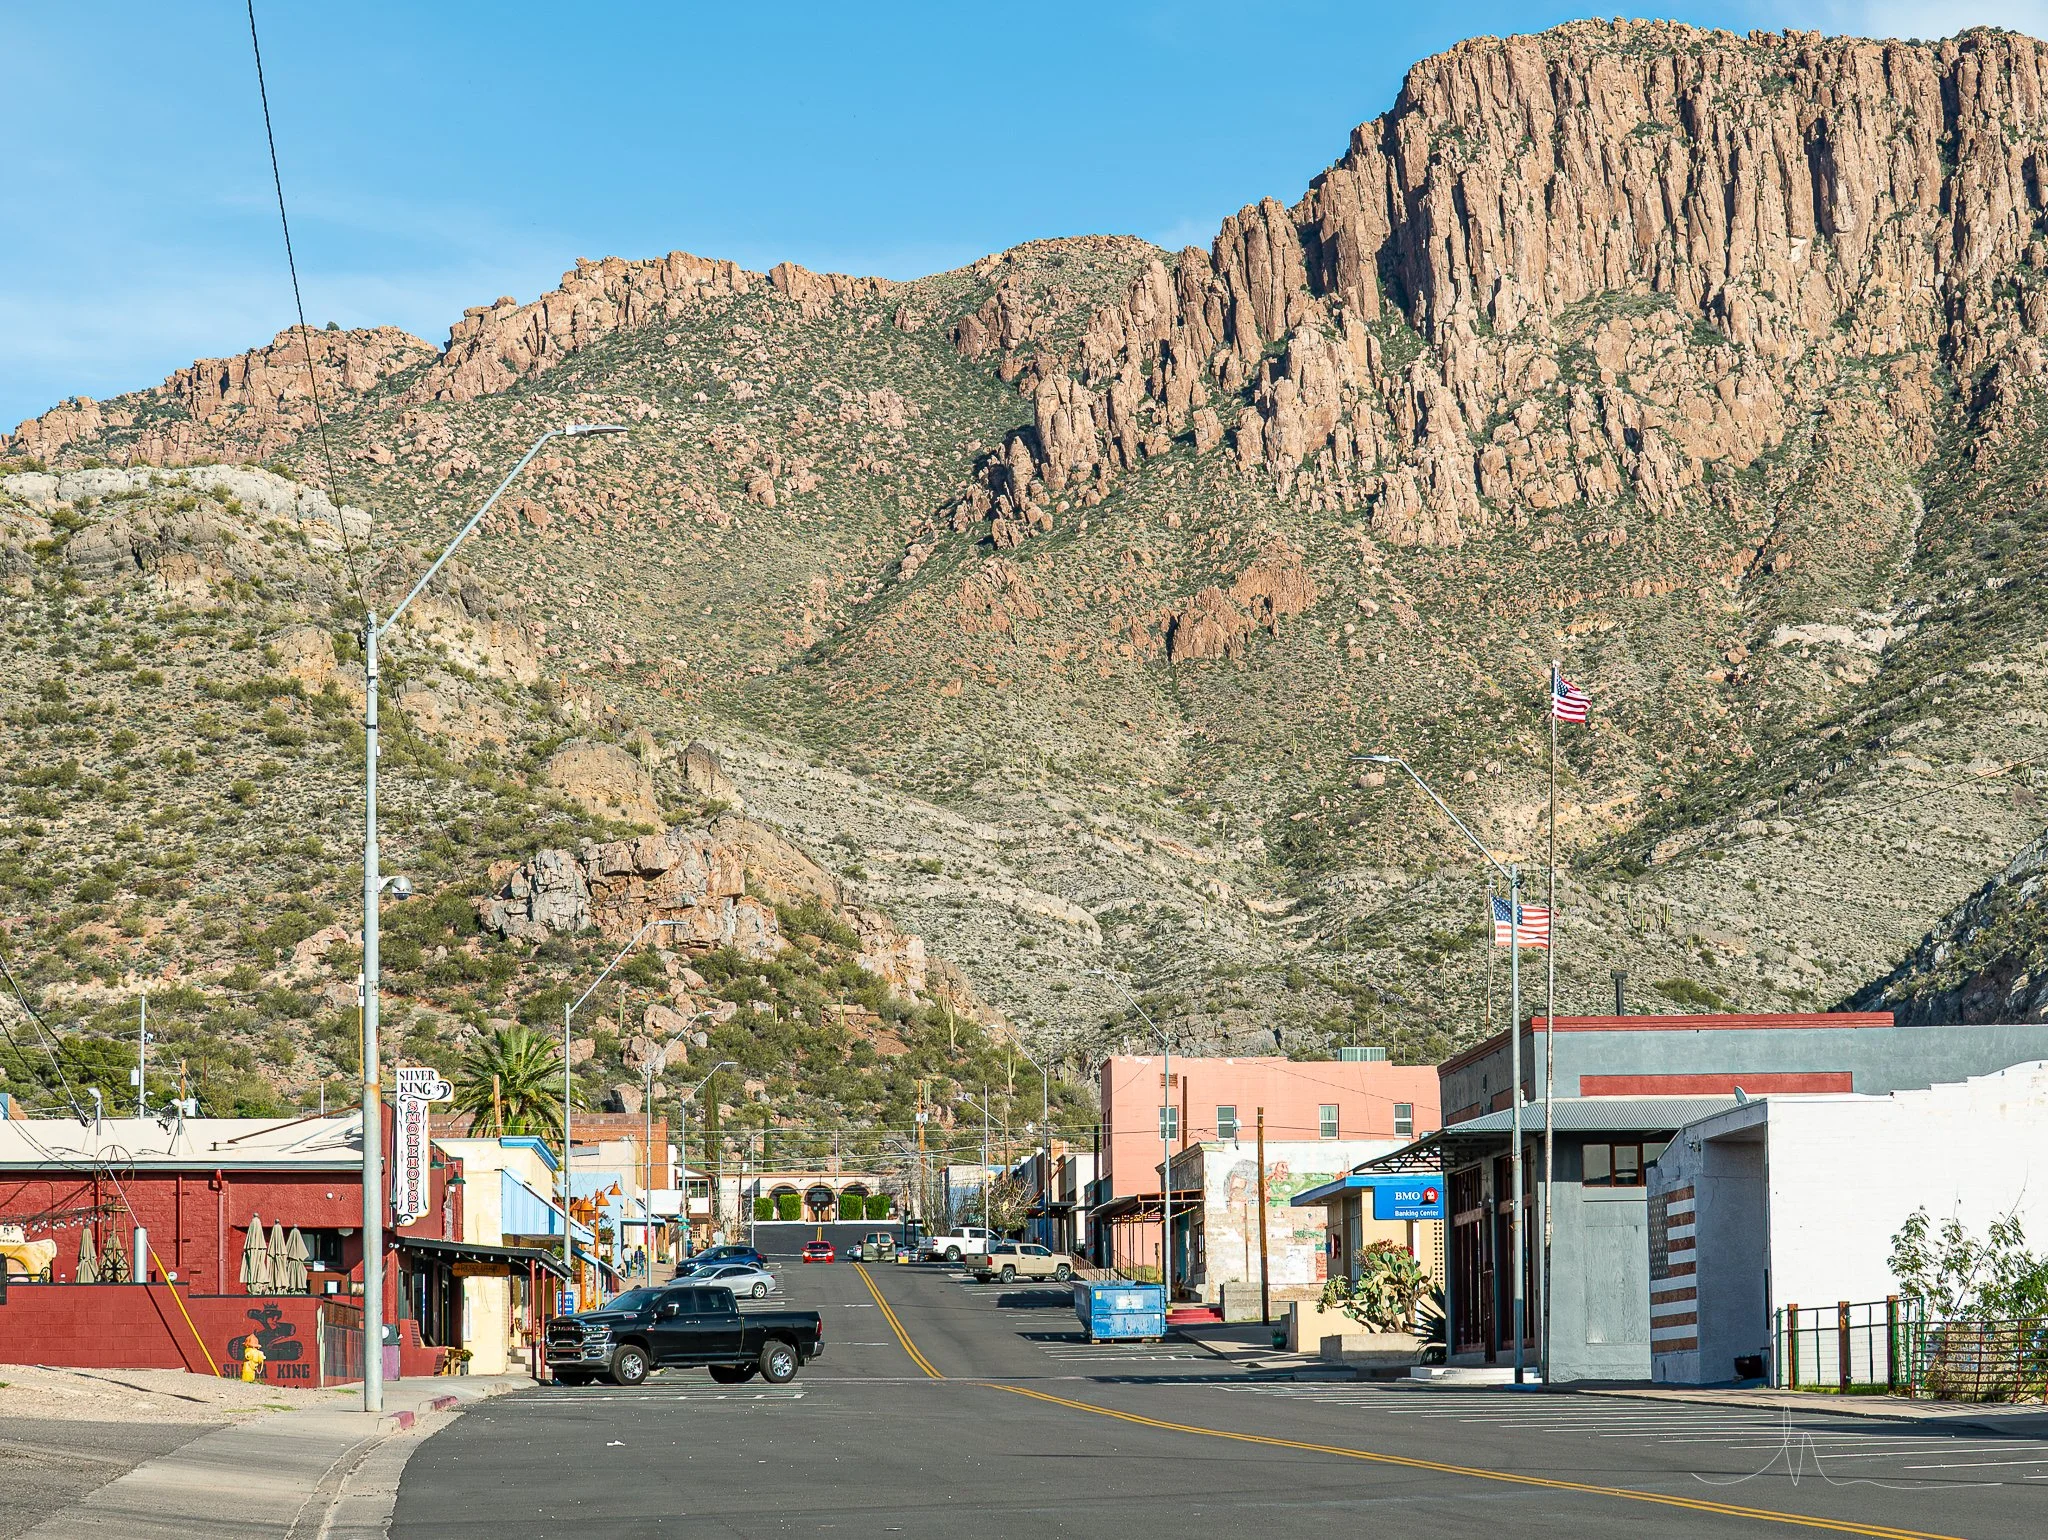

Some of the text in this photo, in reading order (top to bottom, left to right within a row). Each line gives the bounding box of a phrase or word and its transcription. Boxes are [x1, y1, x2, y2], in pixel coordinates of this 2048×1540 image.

[399, 1070, 435, 1081] SILVER
[400, 1082, 431, 1095] KING
[405, 1101, 420, 1213] SMOKEHOUSE
[1395, 1191, 1420, 1200] BMO
[277, 1364, 311, 1379] KING
